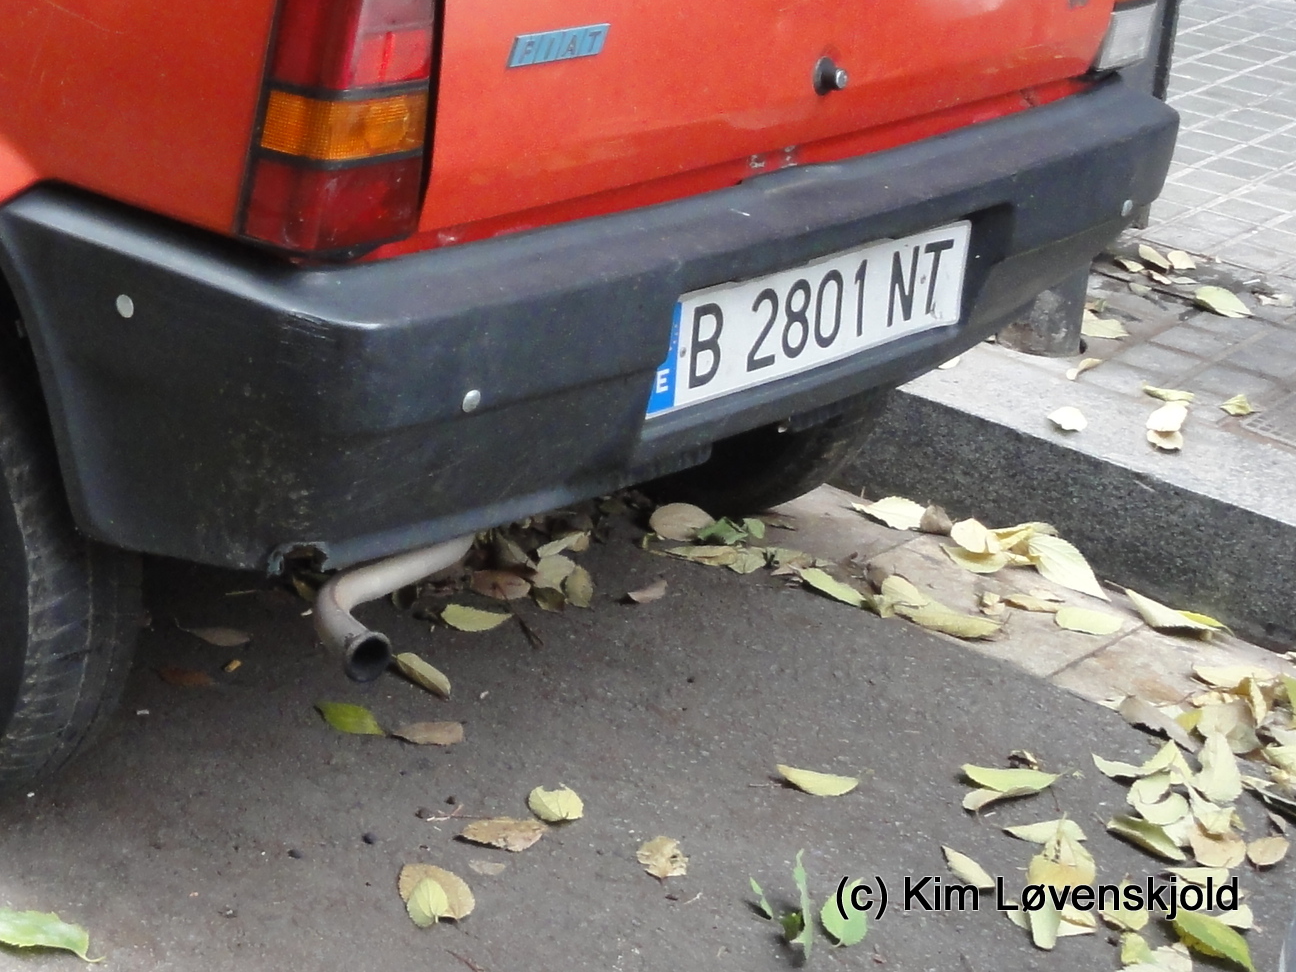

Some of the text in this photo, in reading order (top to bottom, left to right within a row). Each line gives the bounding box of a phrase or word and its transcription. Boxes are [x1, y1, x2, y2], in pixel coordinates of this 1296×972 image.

[515, 28, 604, 65] FIAT
[688, 239, 954, 389] B 2801 NT
[655, 368, 670, 394] E
